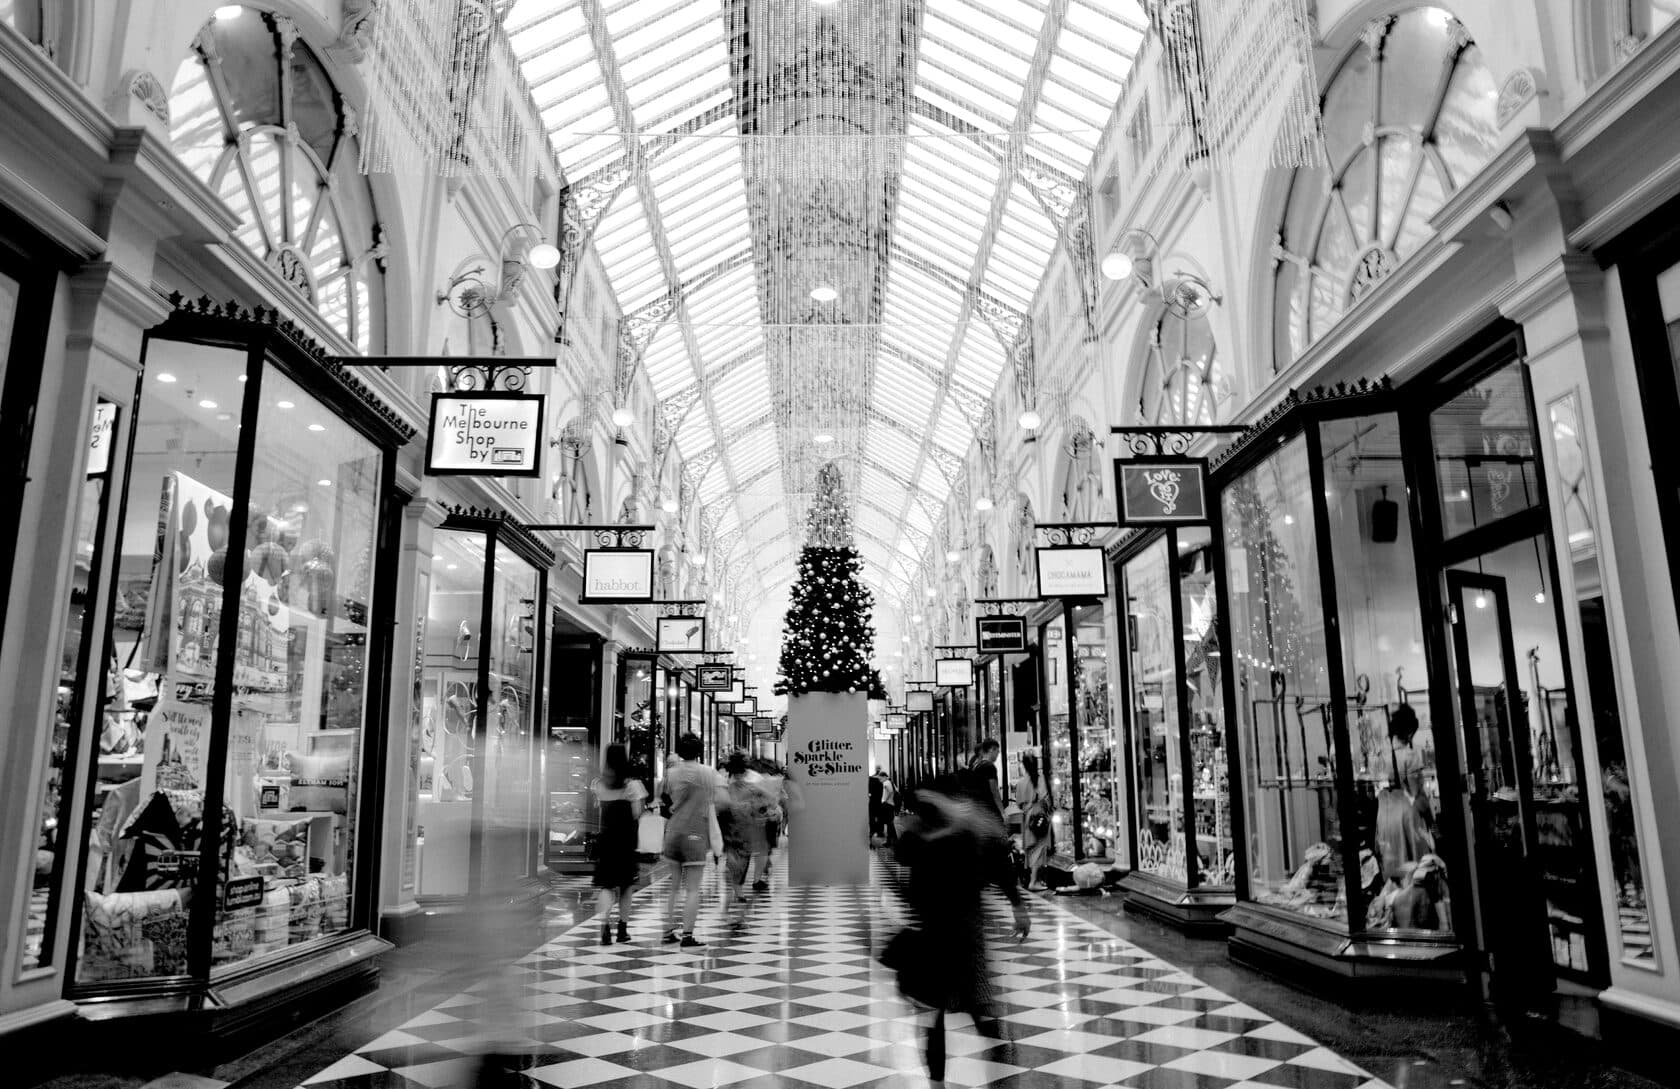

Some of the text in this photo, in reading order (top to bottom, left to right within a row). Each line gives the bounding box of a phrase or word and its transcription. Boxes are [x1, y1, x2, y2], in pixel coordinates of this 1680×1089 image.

[459, 403, 487, 418] The
[443, 415, 528, 430] Melbourne
[456, 430, 496, 448] Shop
[470, 449, 489, 463] by
[793, 750, 843, 764] Sparkle
